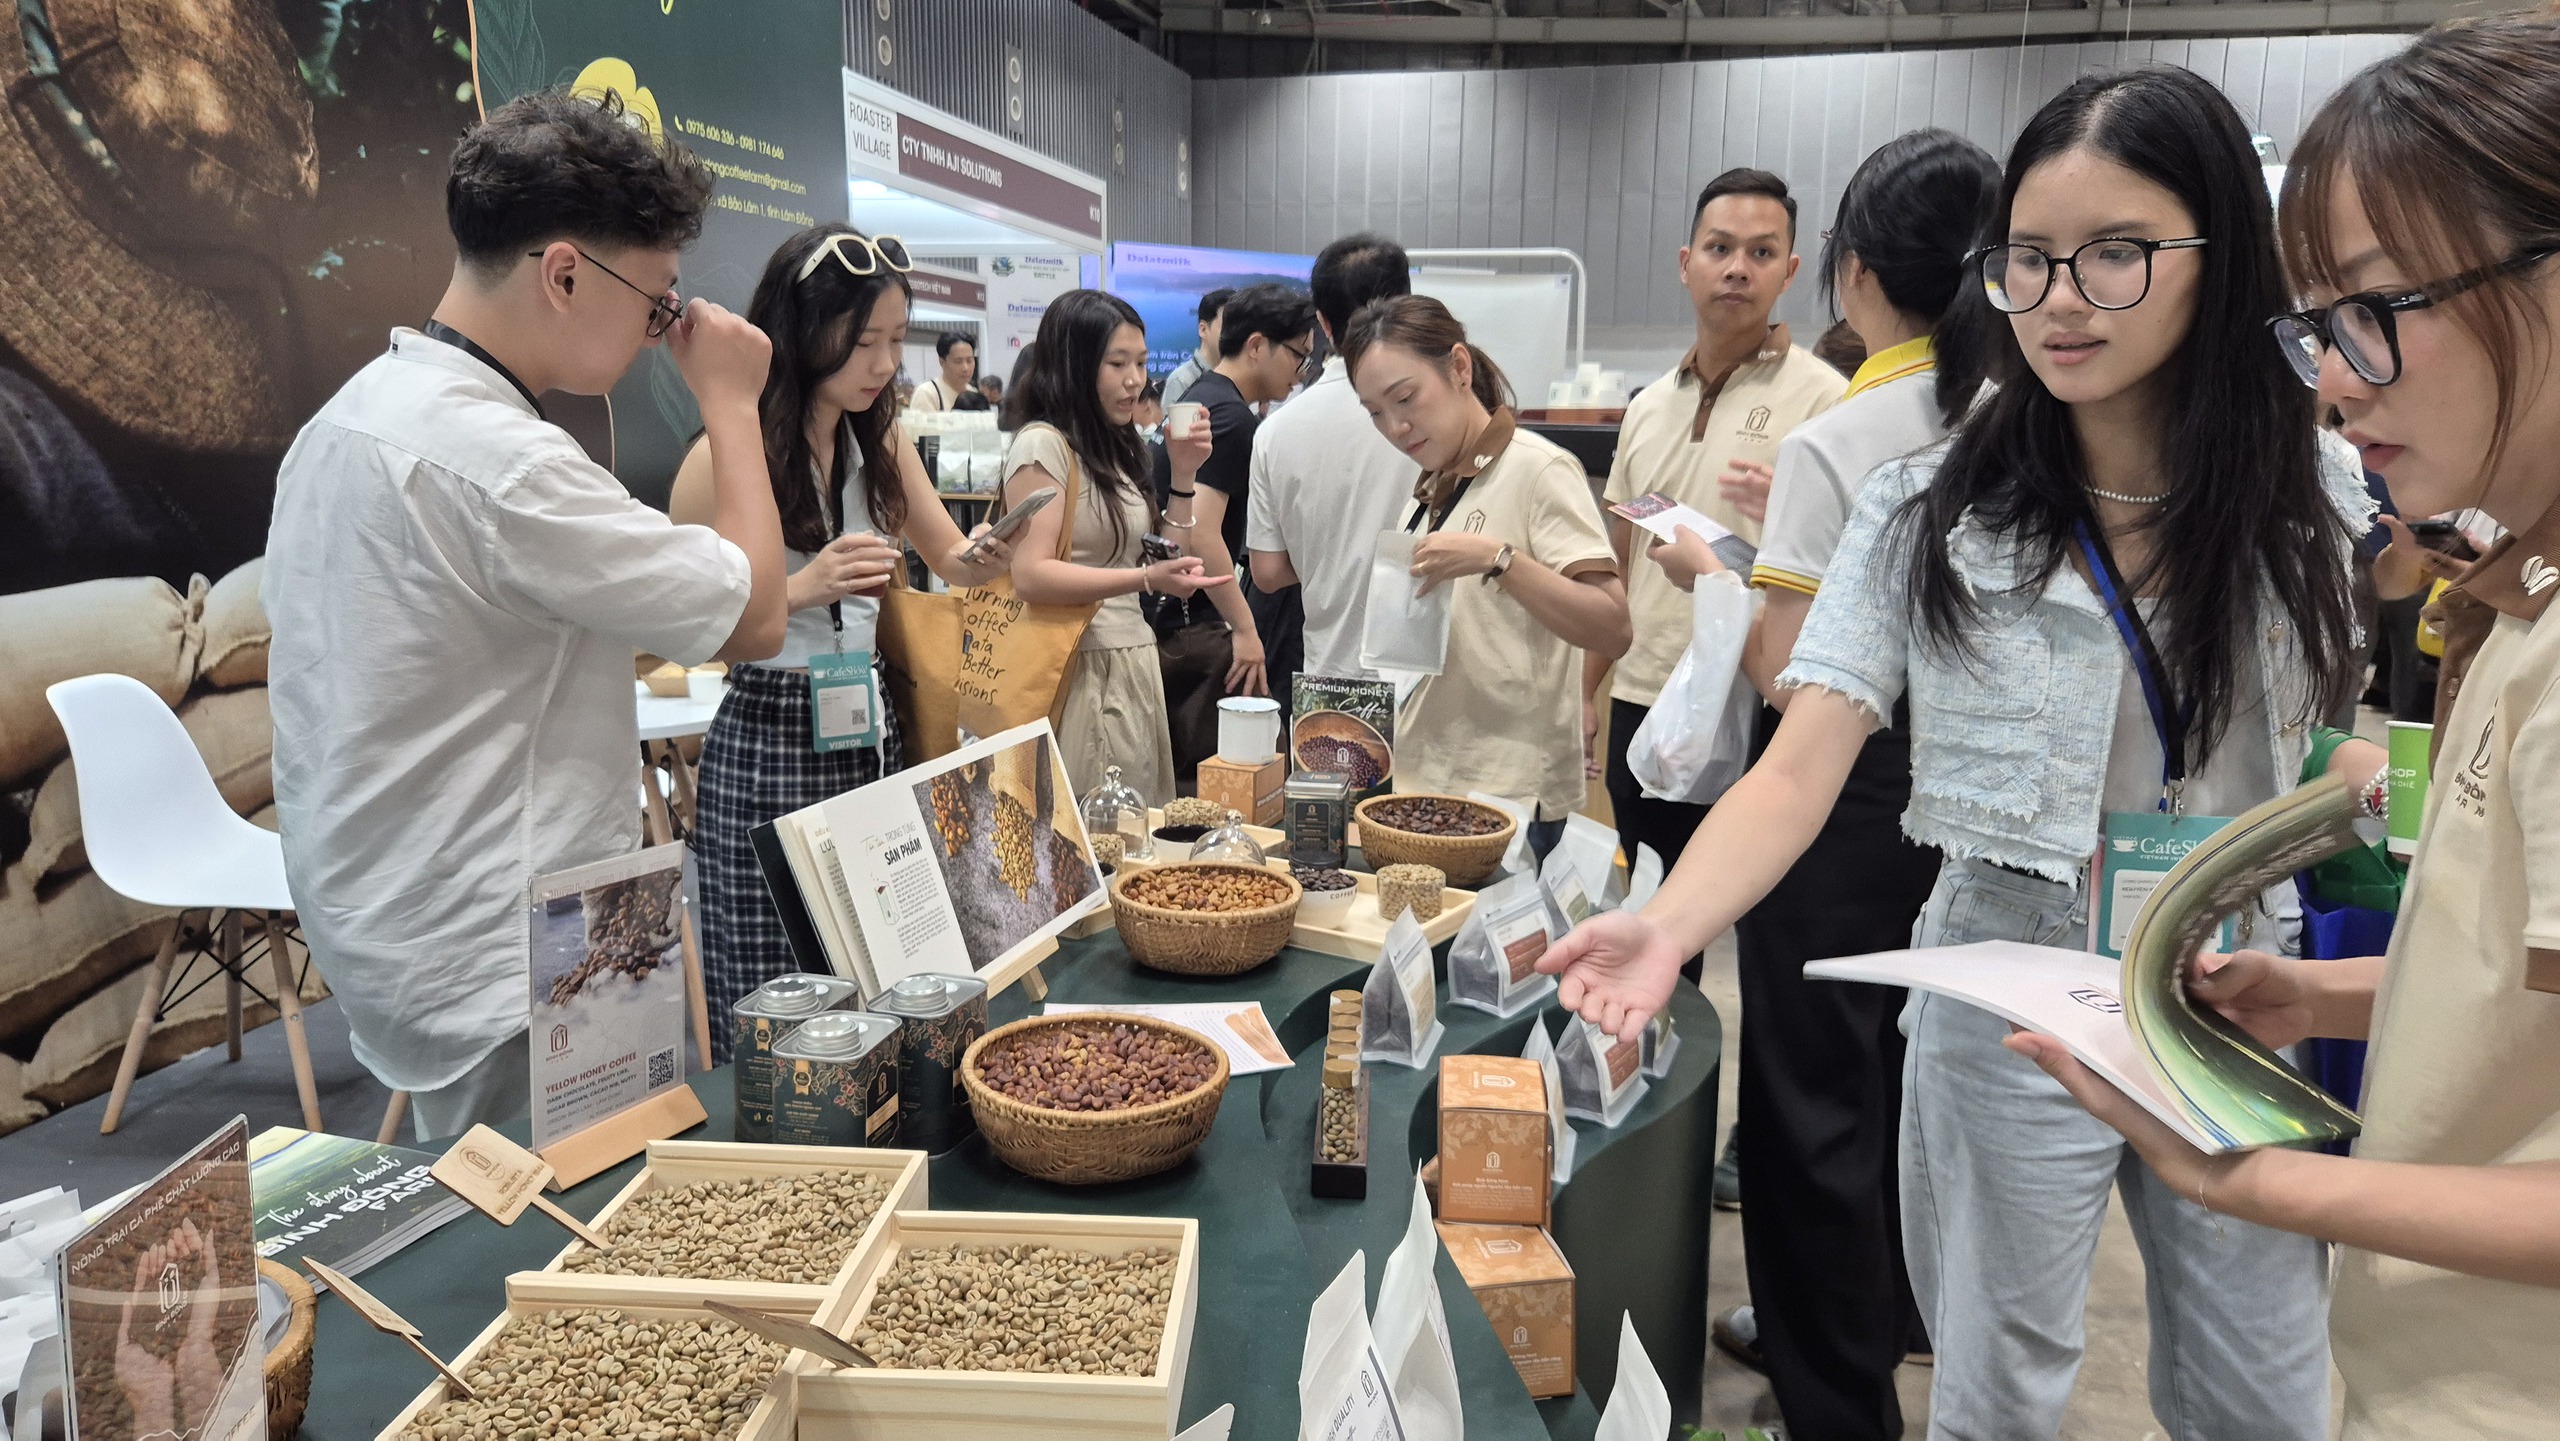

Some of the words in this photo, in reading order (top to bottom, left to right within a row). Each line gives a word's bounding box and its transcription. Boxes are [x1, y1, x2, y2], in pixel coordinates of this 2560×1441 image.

[849, 101, 893, 134] ROASTER
[686, 118, 706, 138] 0975
[706, 125, 720, 142] 606
[739, 135, 757, 152] 0981
[758, 140, 771, 157] 174
[853, 130, 891, 160] VILLAGE
[902, 135, 919, 158] CTY
[921, 142, 946, 167] TNHH
[946, 151, 961, 172] AJI
[960, 156, 1003, 189] SOLUTIONS
[1127, 253, 1191, 267] Dalatmilk
[1007, 302, 1048, 314] Dalatmil
[965, 587, 1024, 623] Turning
[962, 628, 993, 656] Data
[962, 653, 1006, 680] Better
[954, 679, 999, 706] isions
[1301, 682, 1350, 694] PREMIUM
[1351, 687, 1390, 697] HONEY
[1338, 697, 1390, 719] Coffee
[829, 738, 863, 750] VISITOR
[2463, 781, 2487, 802] ĐÔN
[884, 846, 901, 866] SẢN
[900, 835, 923, 859] PHẨM
[1330, 891, 1354, 900] COFFEE
[545, 1074, 579, 1095] YELLOW
[579, 1064, 607, 1081] HONEY
[608, 1051, 637, 1070] COFFEE
[546, 1094, 563, 1105] DARK
[563, 1082, 597, 1098] CHOCOLATE,
[597, 1073, 617, 1084] FRUITY
[616, 1068, 630, 1077] LIKE,
[546, 1104, 566, 1115] SUGAR
[566, 1095, 590, 1107] BROWN,
[589, 1086, 609, 1097] CACAO
[620, 1073, 638, 1085] NUTTY
[256, 1206, 305, 1227] The
[306, 1184, 358, 1208] story
[352, 1154, 402, 1186] about
[71, 1243, 104, 1275] NÔNG
[105, 1226, 129, 1249] TRẠI
[222, 1141, 241, 1162] CAO
[223, 1404, 256, 1441] OFFEE
